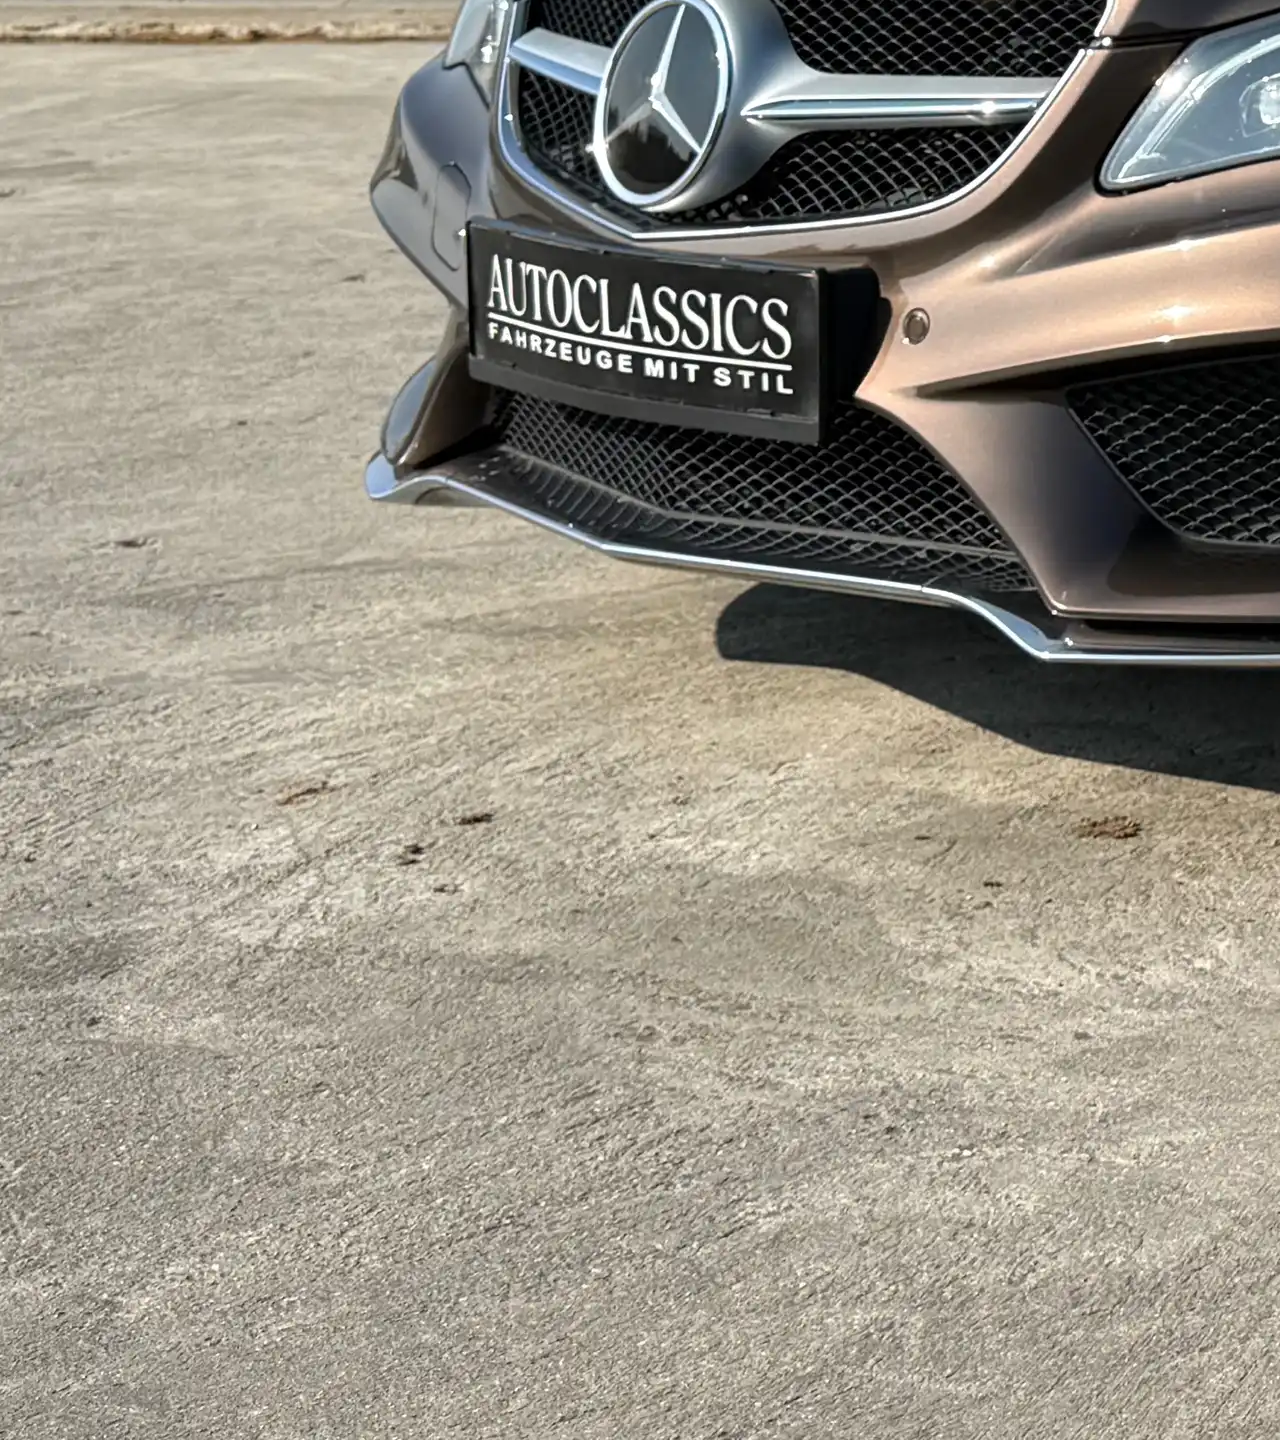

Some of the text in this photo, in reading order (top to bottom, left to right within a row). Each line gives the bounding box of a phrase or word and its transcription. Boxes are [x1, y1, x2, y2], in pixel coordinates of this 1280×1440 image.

[487, 254, 793, 359] AUTOCLASSICS
[488, 320, 794, 395] FAHRZEUGE MIT STIL
